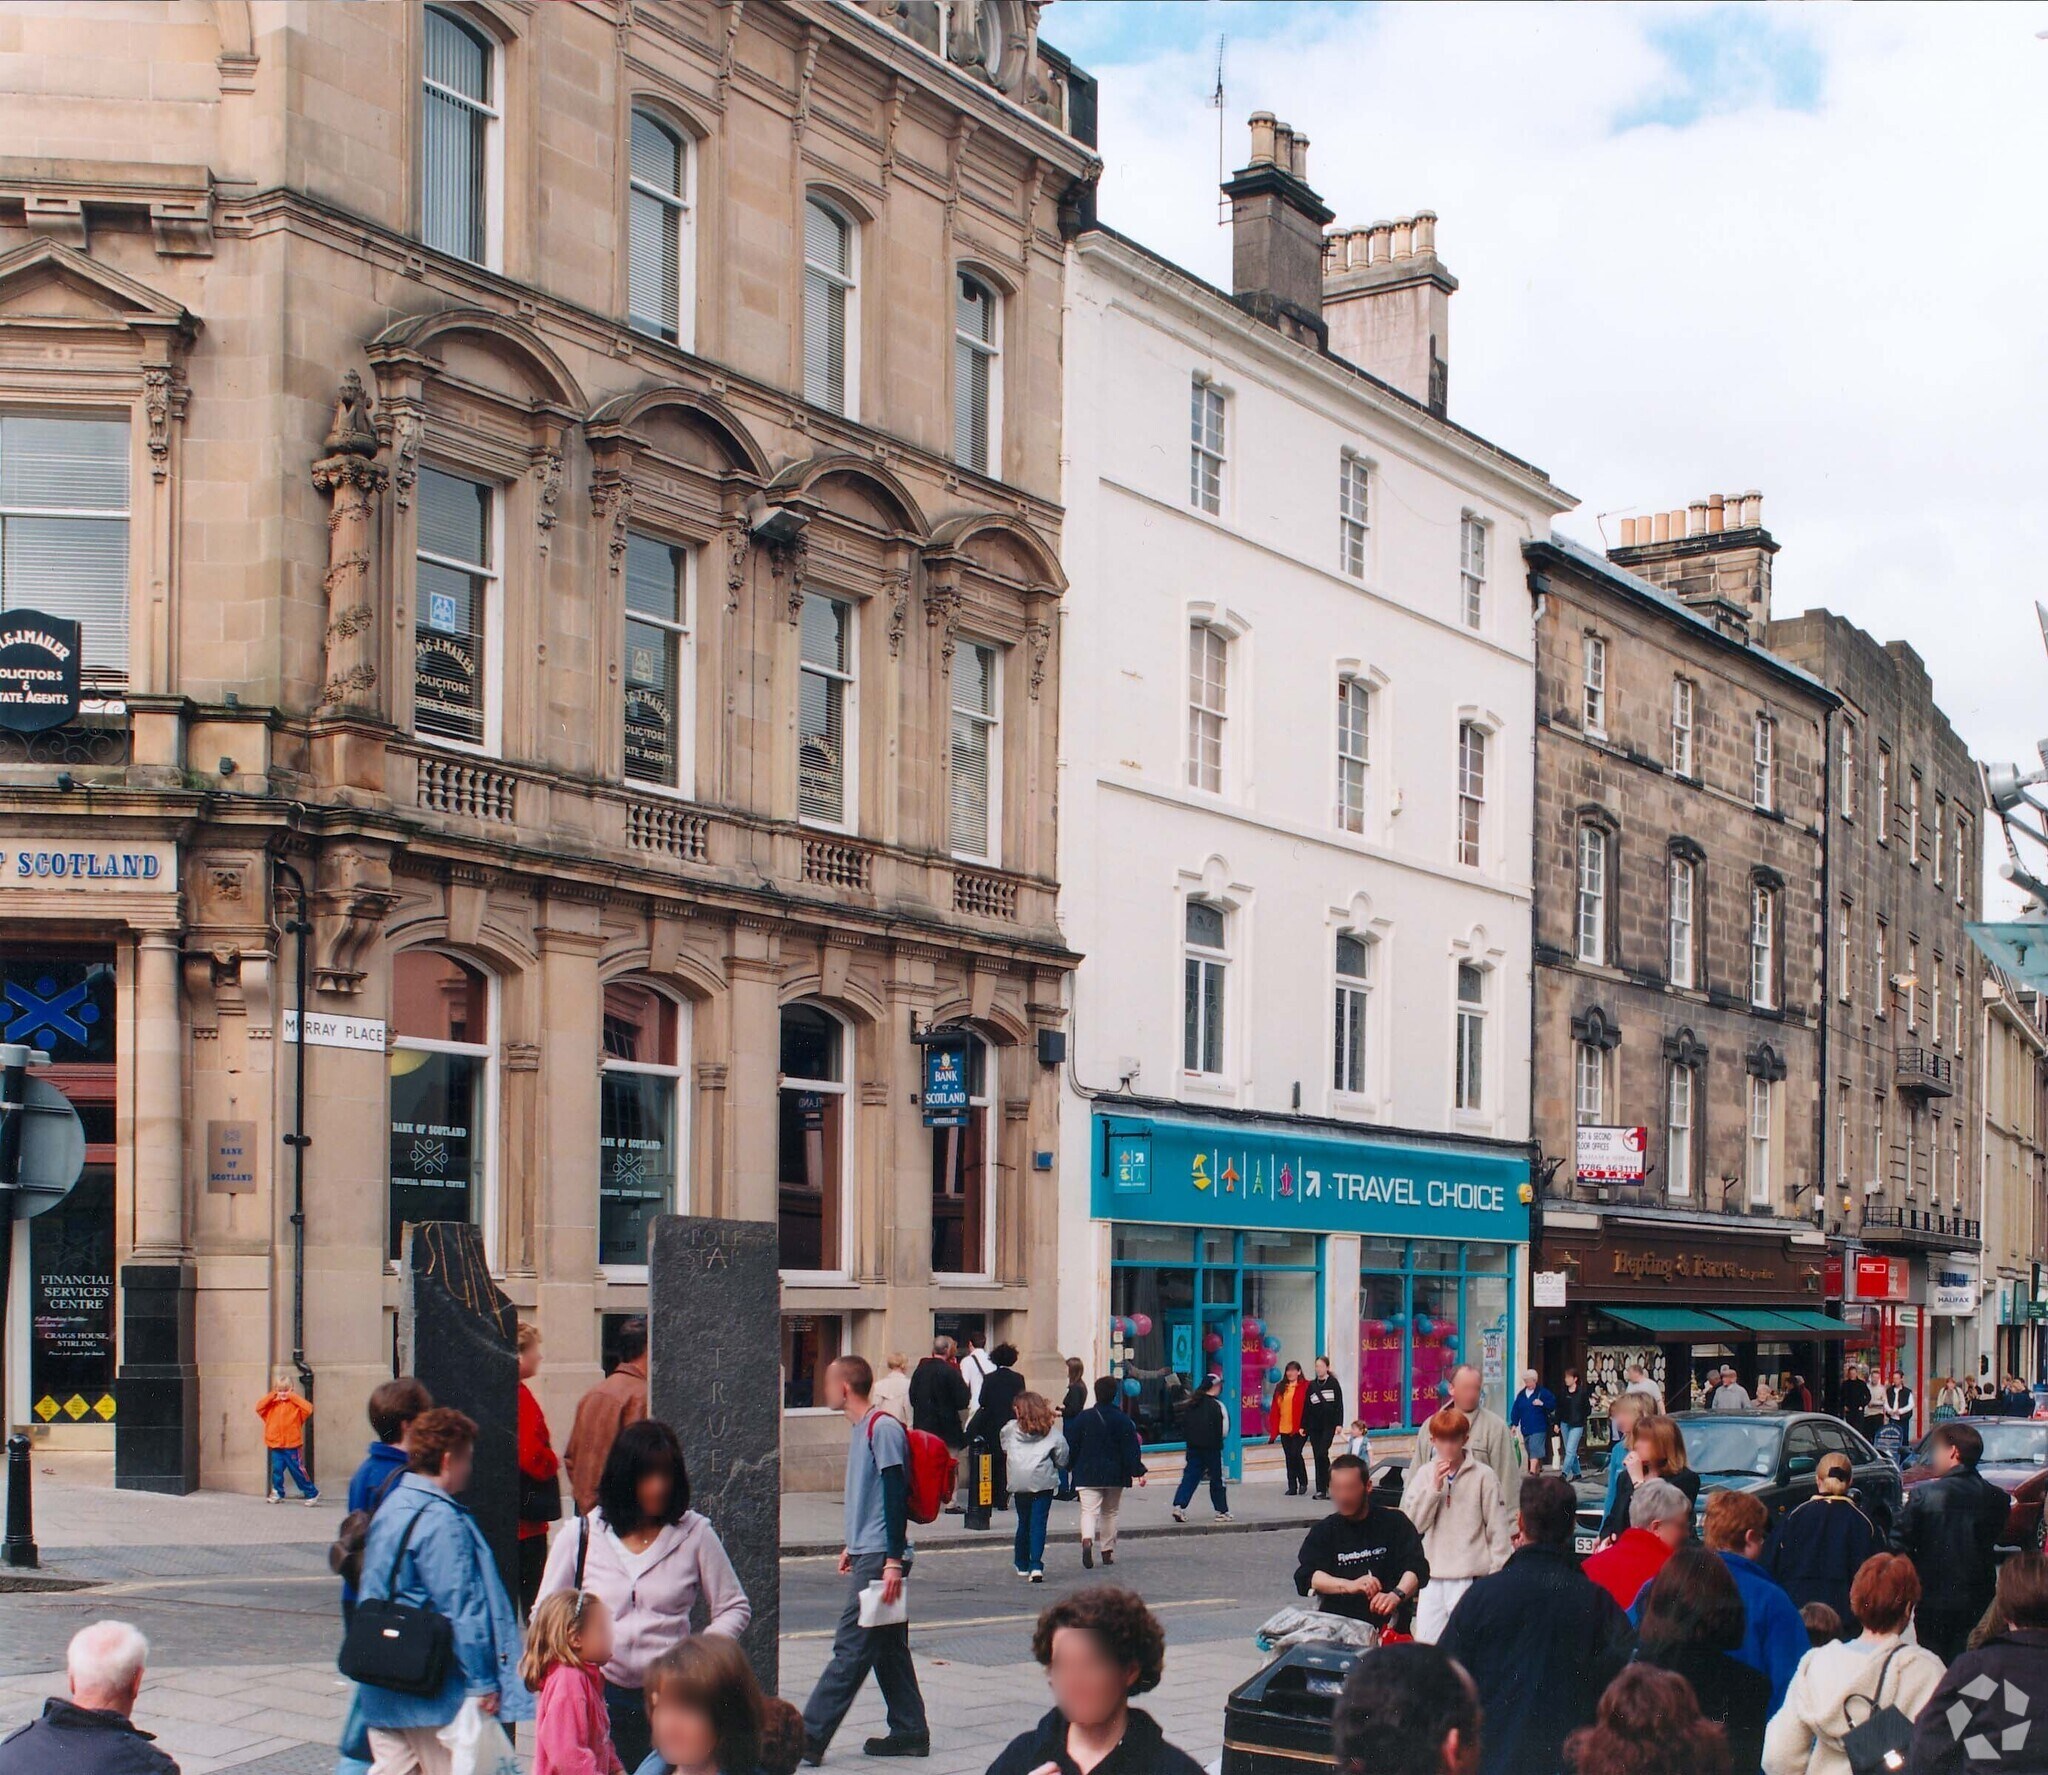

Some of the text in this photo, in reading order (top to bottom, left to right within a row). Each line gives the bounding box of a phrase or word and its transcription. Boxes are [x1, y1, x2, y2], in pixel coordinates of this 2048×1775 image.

[0, 668, 63, 681] OLICITORS
[22, 680, 31, 690] &
[0, 690, 69, 704] TATE AGENTS
[624, 723, 668, 742] OLICITORS
[18, 851, 161, 879] SCOTLAND
[285, 1018, 383, 1042] MRRAY PLACE
[934, 1070, 958, 1082] BANK
[925, 1092, 966, 1105] SCOTLAND
[392, 1121, 467, 1138] BANK OF SCOTLAND
[628, 1138, 661, 1151] SCOTLAND
[1592, 1142, 1610, 1152] OFFICES
[220, 1148, 243, 1156] BANK
[210, 1173, 254, 1182] SCOTLAND
[1603, 1170, 1642, 1179] LET
[1332, 1172, 1504, 1212] TRAVEL CHOICE
[41, 1274, 114, 1285] FINANCIAL
[43, 1286, 110, 1297] SERVICES
[49, 1299, 105, 1310] CENTRE
[1937, 1296, 1970, 1304] HALIFAX
[1242, 1339, 1260, 1353] SALE
[1361, 1337, 1399, 1351] SALE SALE
[1412, 1336, 1420, 1348] LE
[1242, 1394, 1259, 1409] SALE
[1361, 1389, 1399, 1404] SALE SALE
[1577, 1538, 1593, 1551] S3
[1337, 1548, 1372, 1563] Reebok
